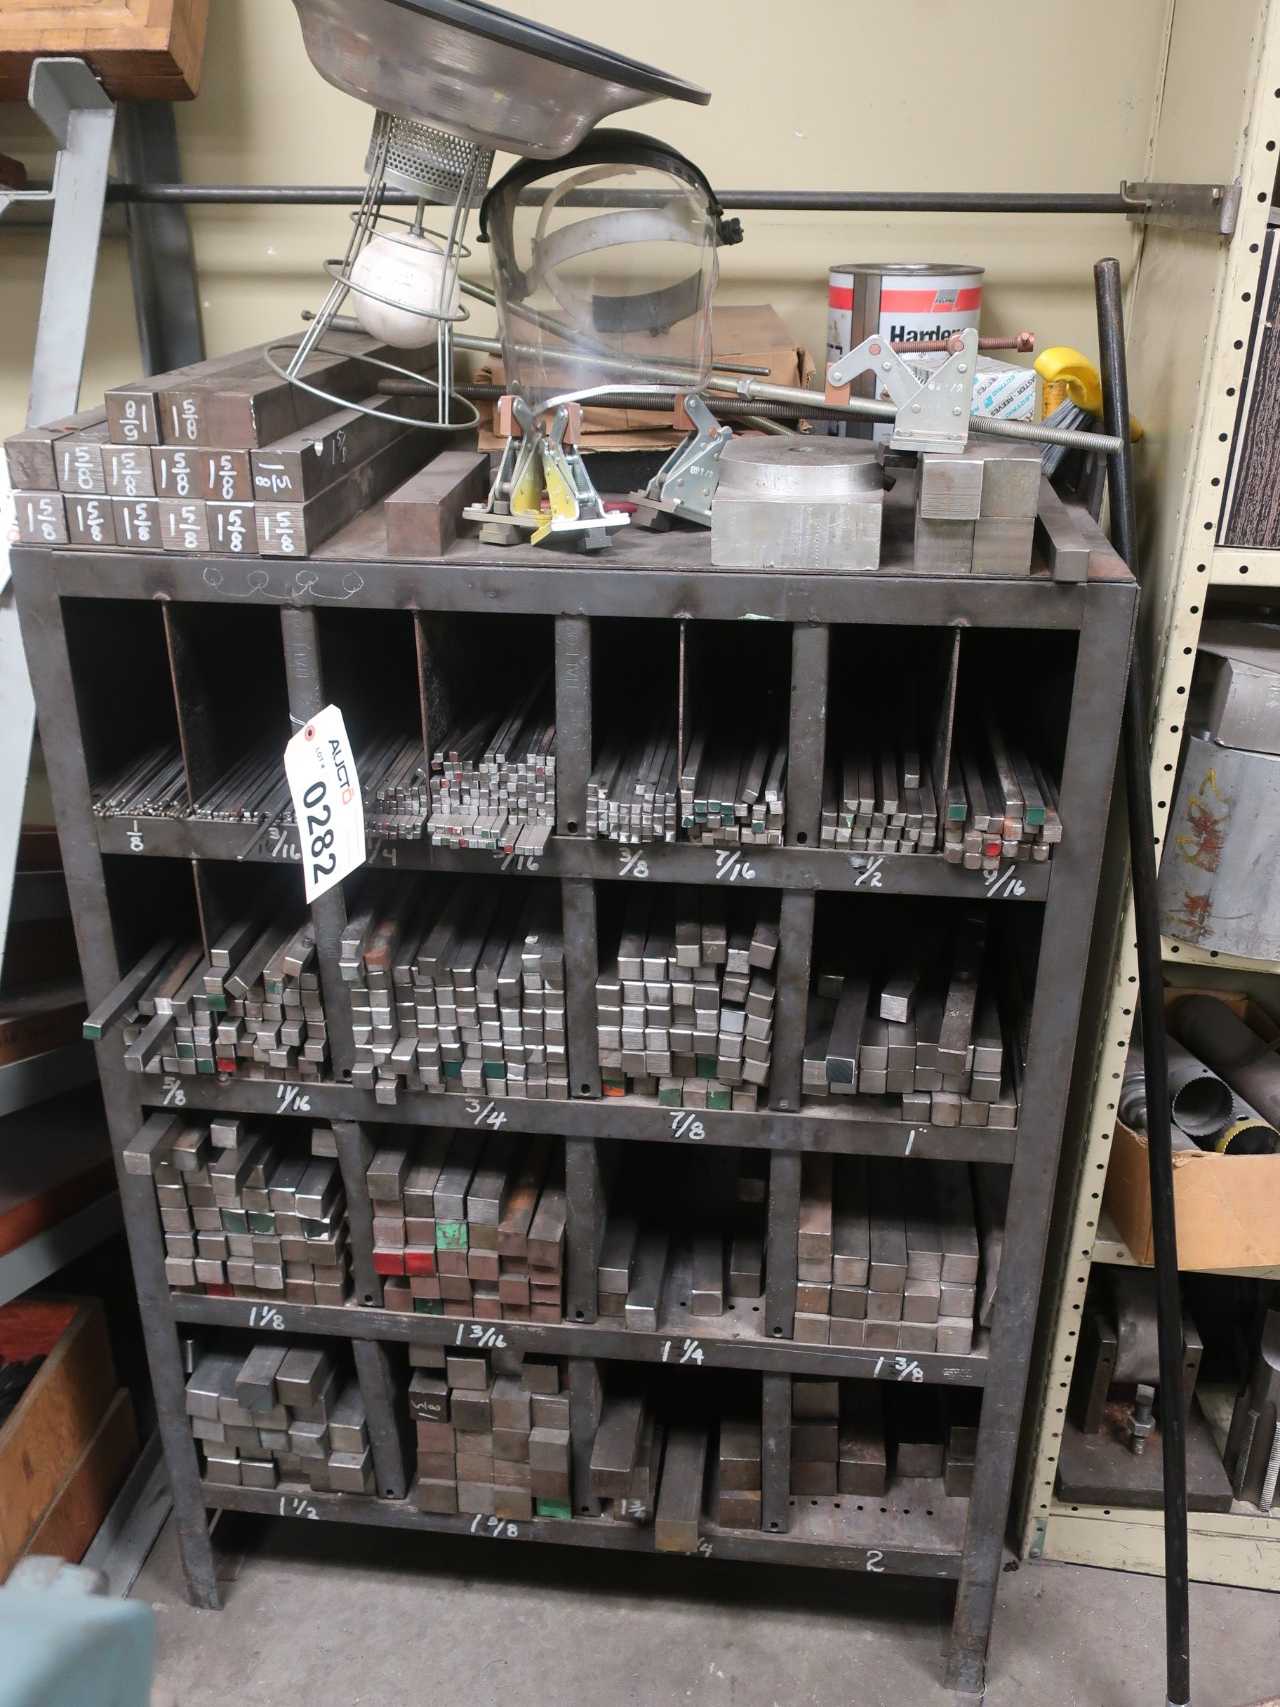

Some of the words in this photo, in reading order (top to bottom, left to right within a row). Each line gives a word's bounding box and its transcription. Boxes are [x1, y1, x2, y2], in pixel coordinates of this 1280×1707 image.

[126, 821, 145, 852] 1/8
[303, 781, 337, 885] 0282
[619, 848, 649, 878] 3/8
[715, 849, 757, 881] 7/16
[853, 855, 884, 888] 1/2
[465, 1098, 507, 1131] 3/4
[669, 1111, 705, 1140] 7/8
[249, 1306, 258, 1327] 1
[261, 1305, 285, 1330] 1/8
[455, 1323, 465, 1345] 1
[661, 1340, 672, 1363] 1
[679, 1338, 704, 1366] 1/4
[873, 1356, 885, 1378] 1
[280, 1496, 286, 1516] 1
[865, 1550, 885, 1573] 2
